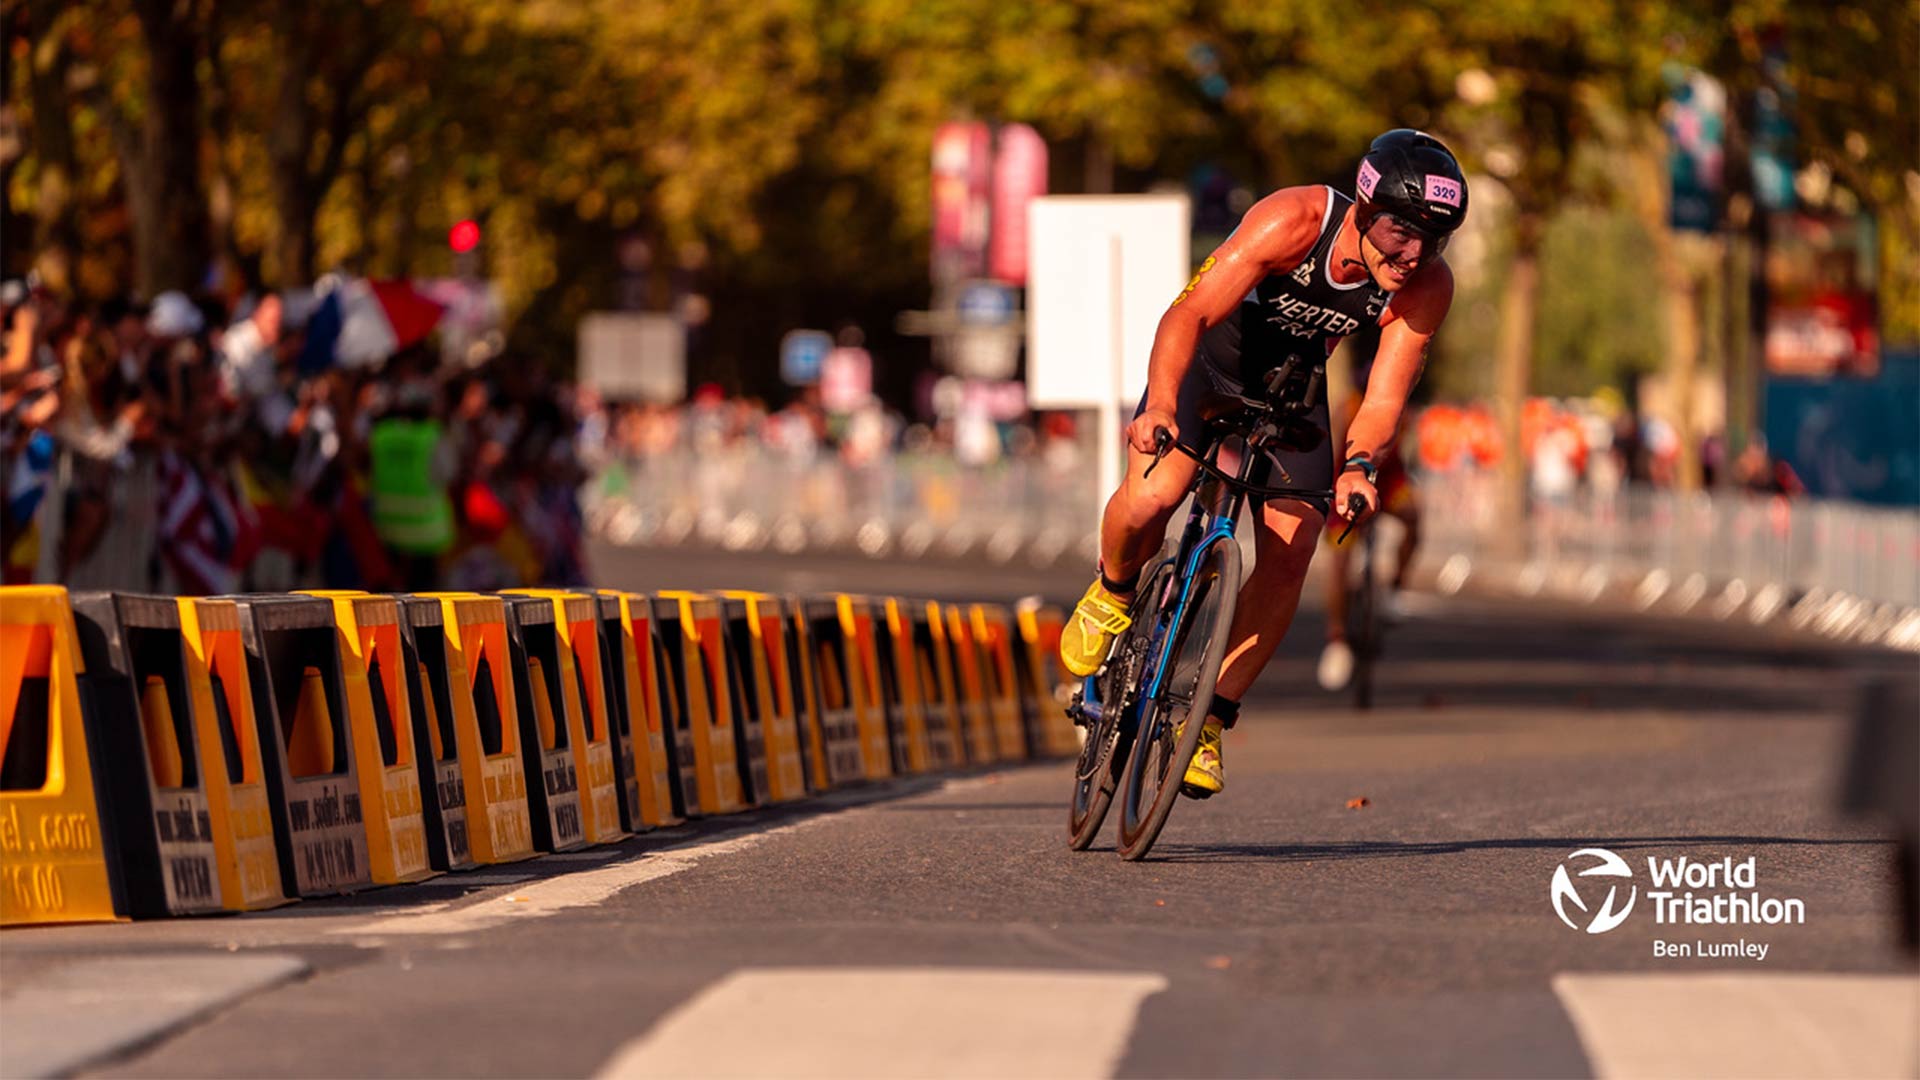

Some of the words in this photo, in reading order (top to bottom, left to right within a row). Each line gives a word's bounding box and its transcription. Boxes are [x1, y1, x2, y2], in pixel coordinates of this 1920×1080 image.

[1432, 185, 1456, 201] 329
[1268, 293, 1360, 334] HERTER
[1266, 316, 1318, 339] FRA
